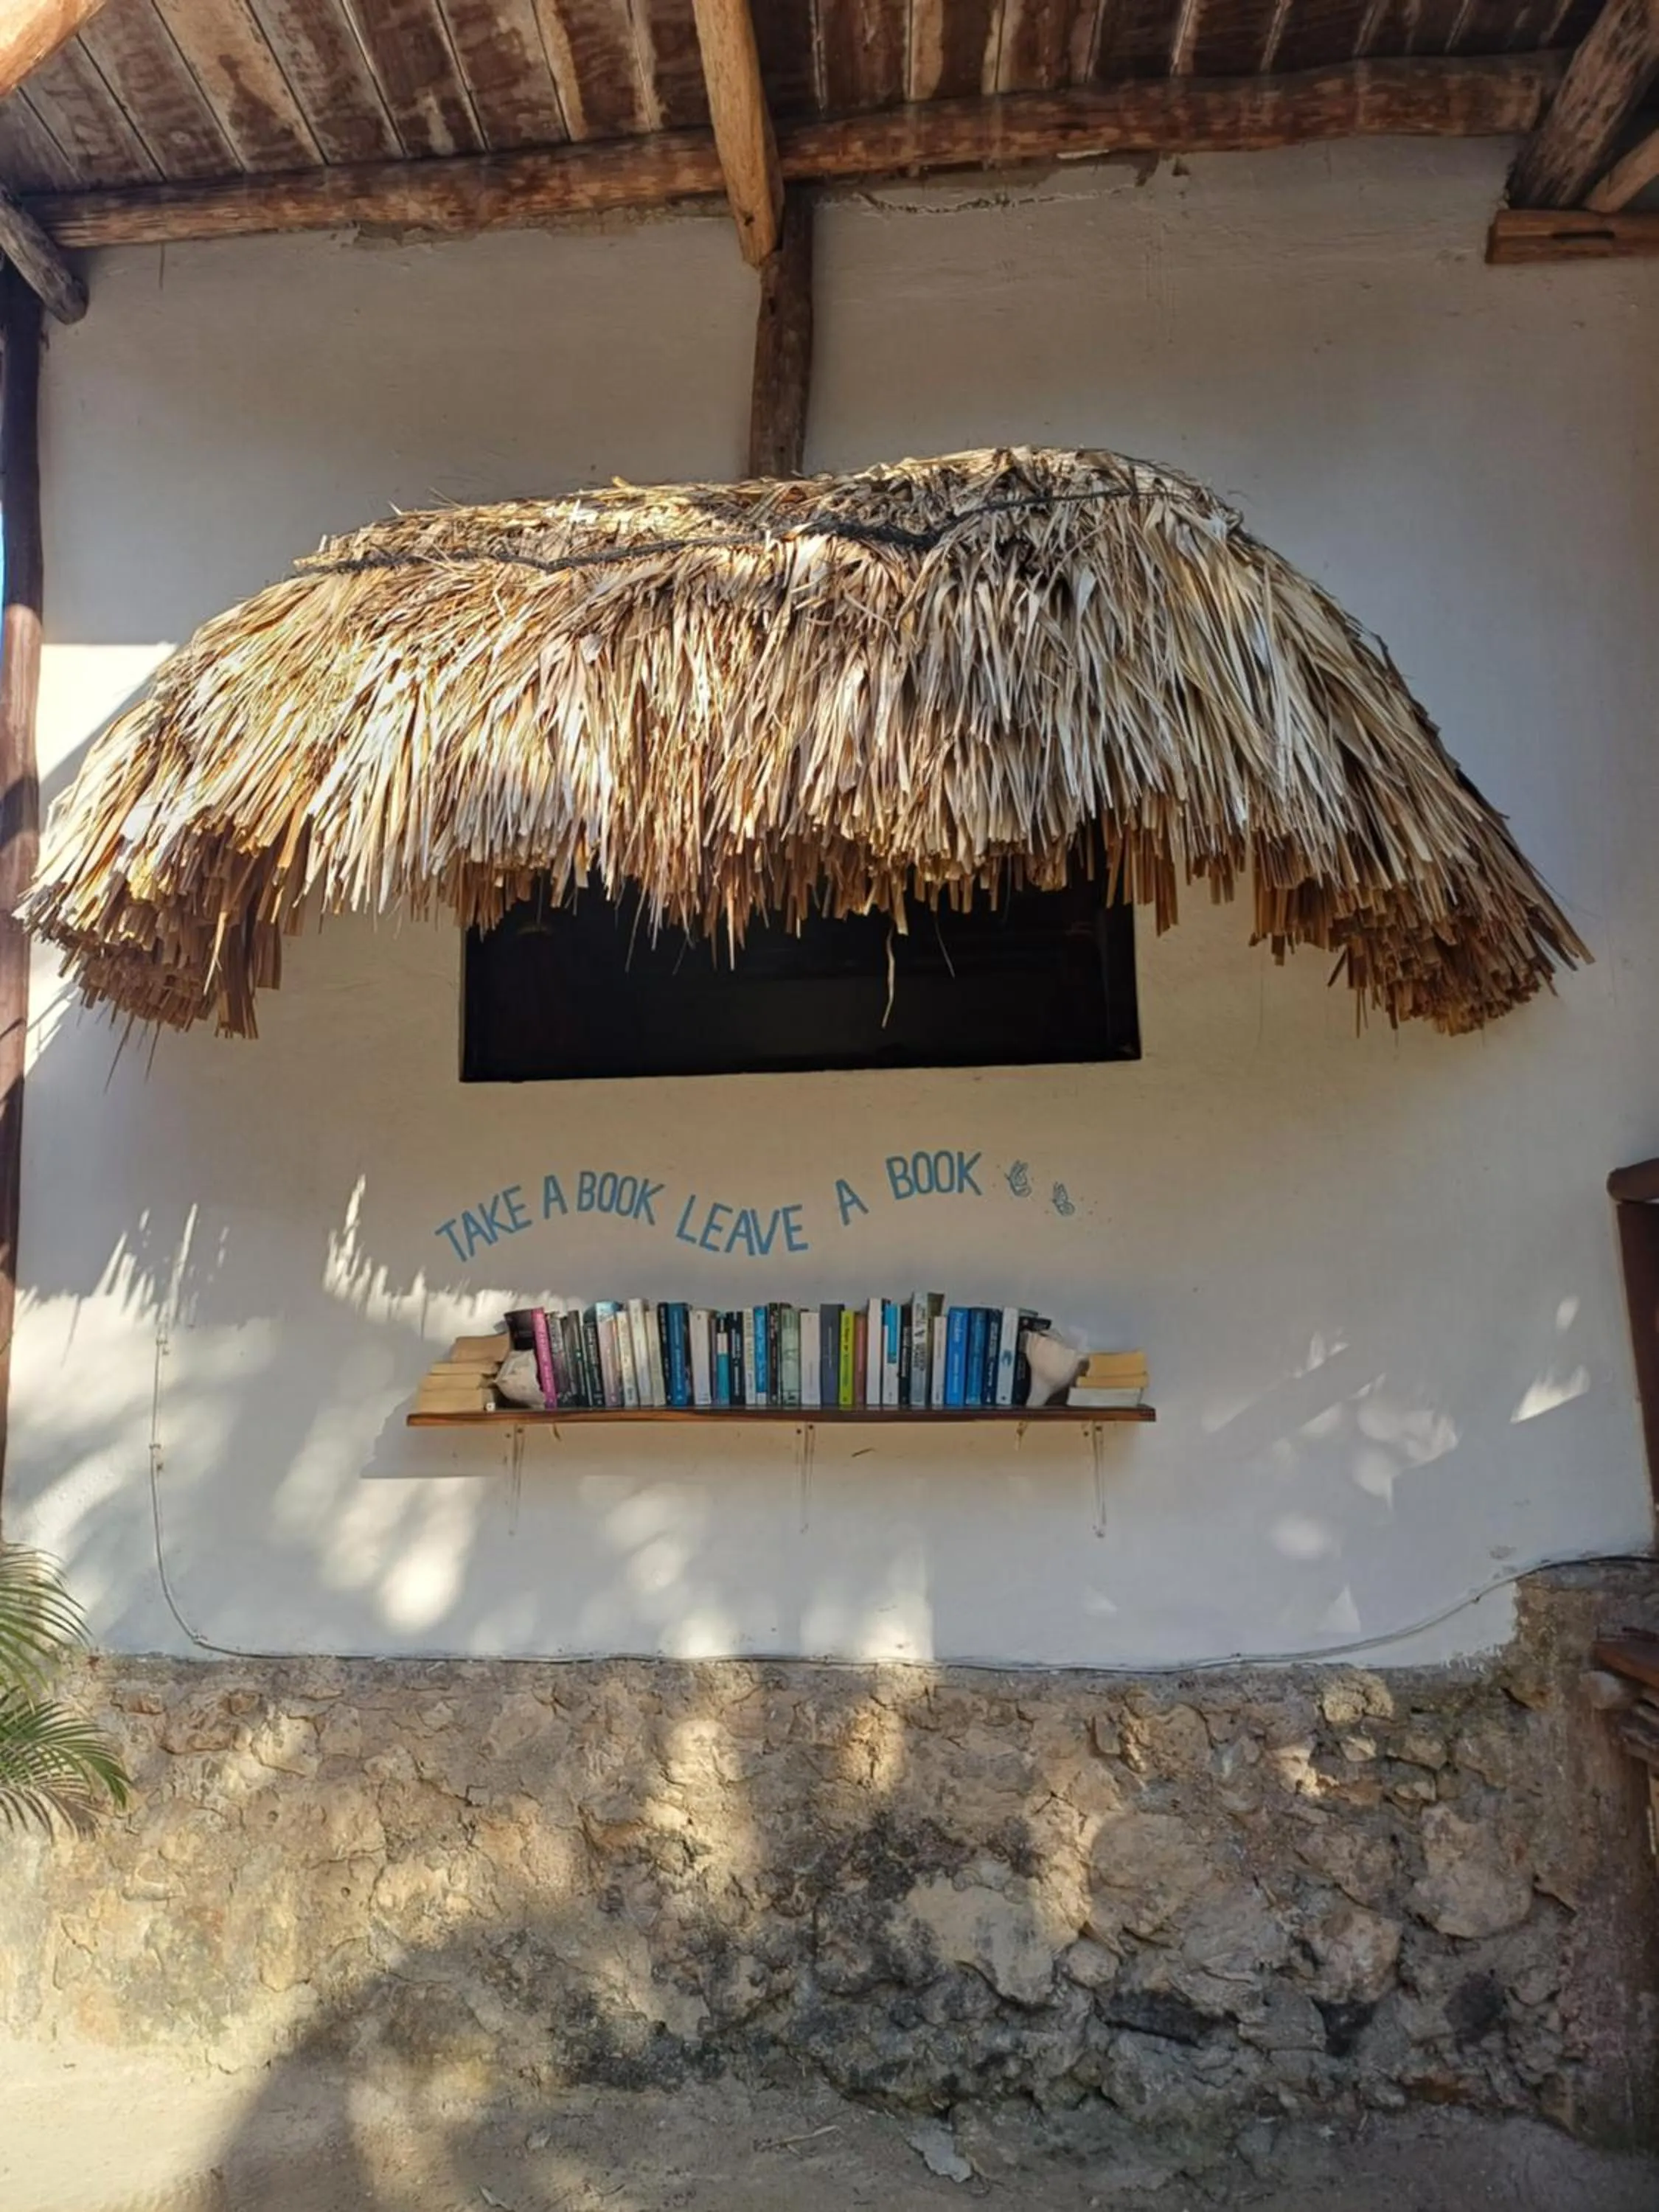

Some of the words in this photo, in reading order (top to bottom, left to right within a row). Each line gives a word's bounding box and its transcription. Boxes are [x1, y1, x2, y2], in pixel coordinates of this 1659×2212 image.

[434, 1185, 532, 1262] TAKE
[543, 1175, 568, 1220] A
[577, 1171, 665, 1225] BOOK
[675, 1194, 808, 1256] LEAVE
[835, 1178, 869, 1226] A
[886, 1150, 982, 1200] BOOK
